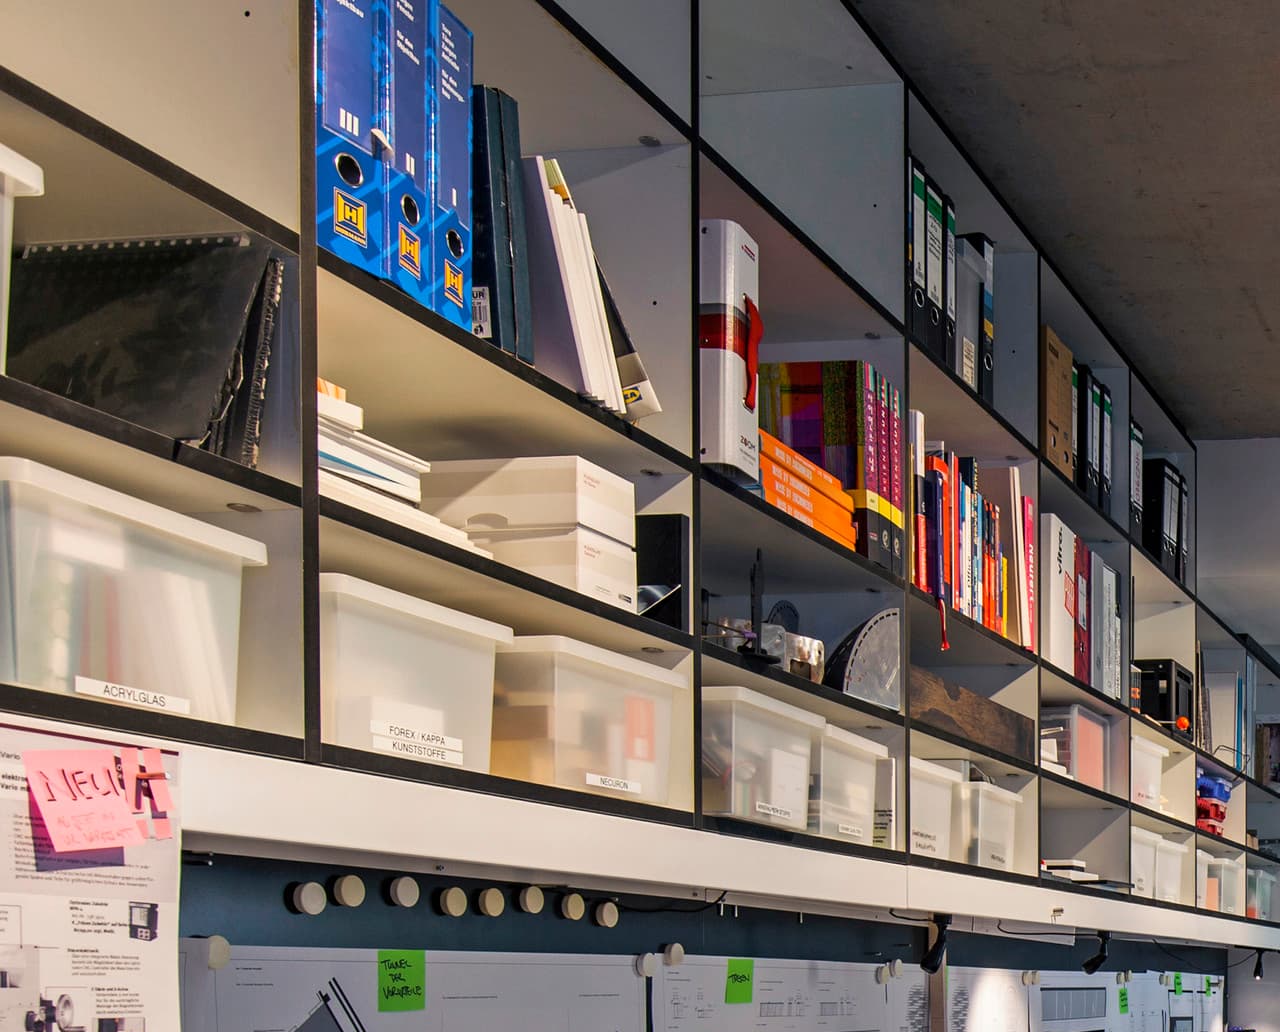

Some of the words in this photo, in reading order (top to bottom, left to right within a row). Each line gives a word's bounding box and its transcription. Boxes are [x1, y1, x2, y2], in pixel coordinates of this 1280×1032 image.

[103, 684, 166, 707] ACRYLGLAS
[389, 725, 416, 740] FOREX
[421, 732, 445, 746] KAPPA
[392, 741, 446, 761] KUNSTSTOFFE
